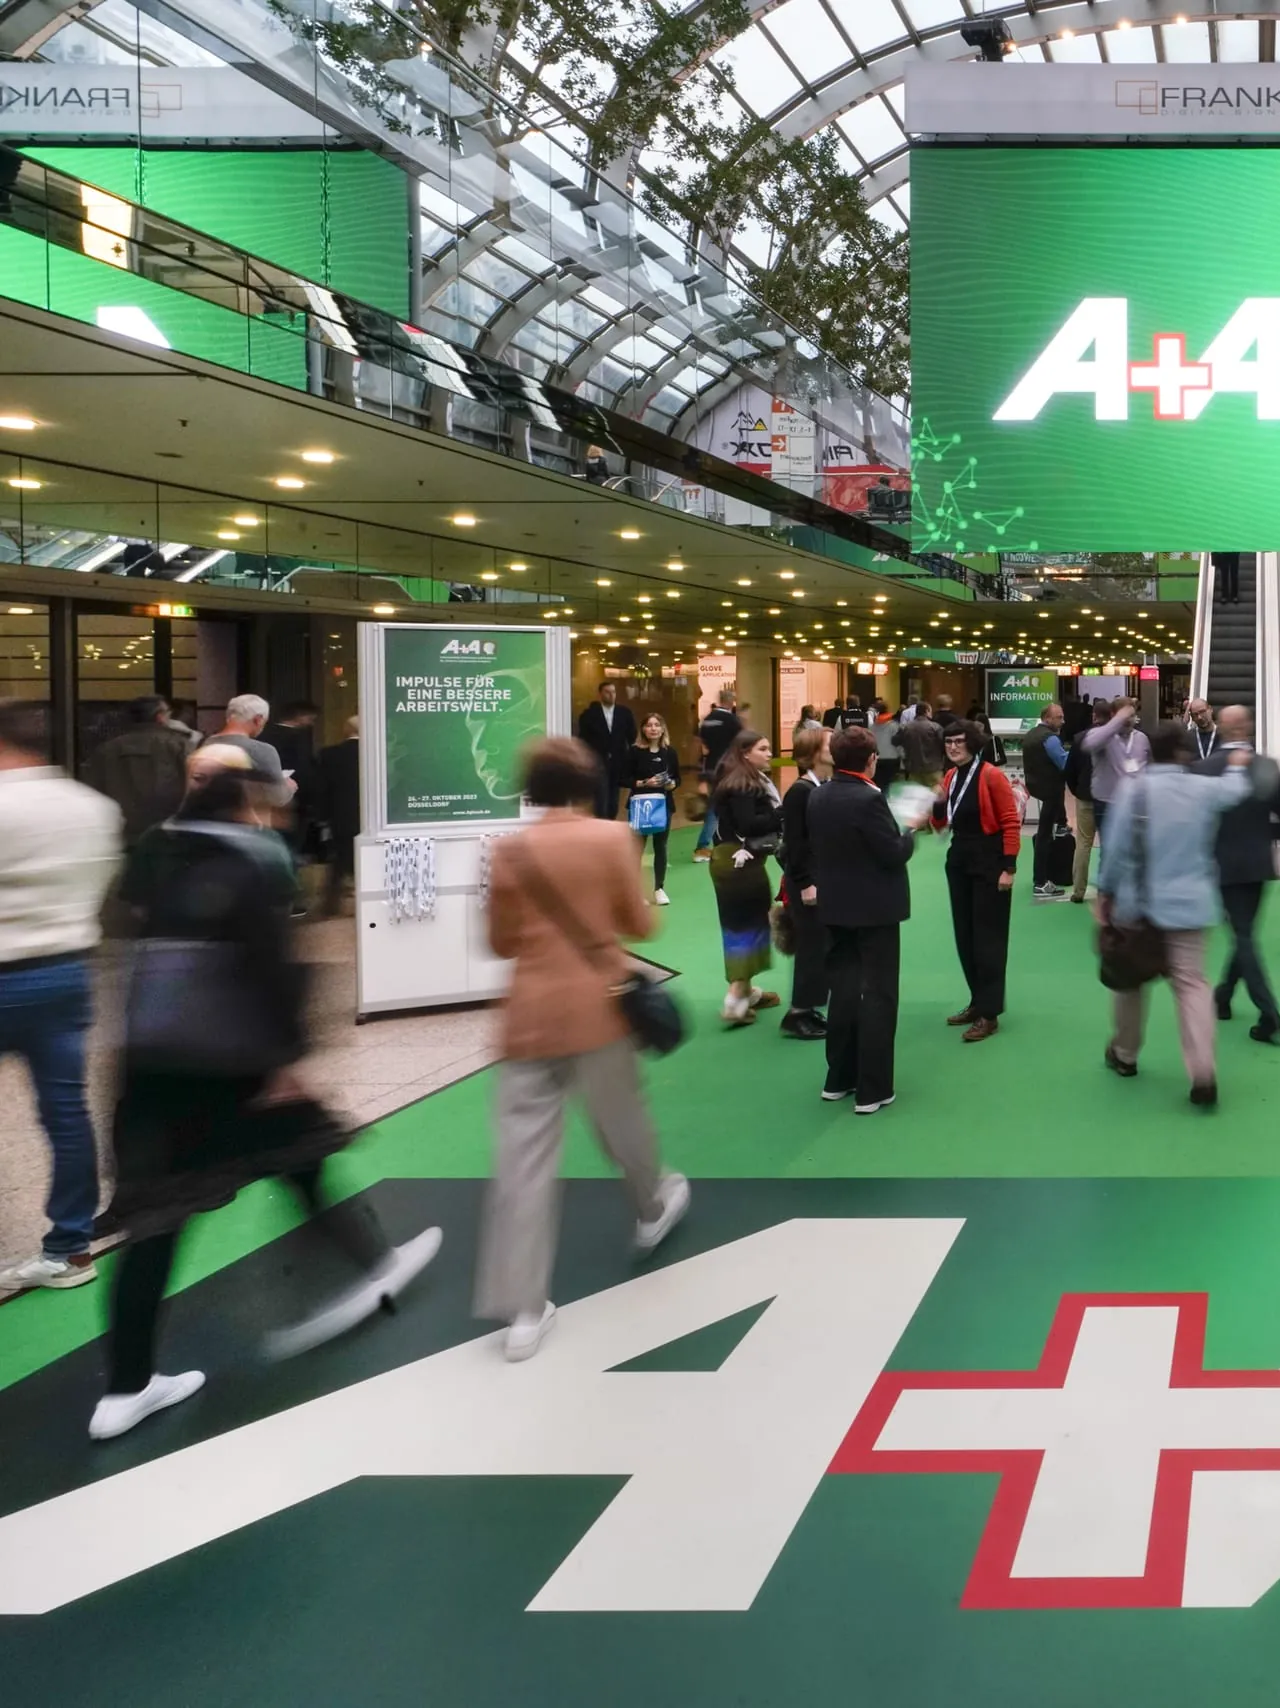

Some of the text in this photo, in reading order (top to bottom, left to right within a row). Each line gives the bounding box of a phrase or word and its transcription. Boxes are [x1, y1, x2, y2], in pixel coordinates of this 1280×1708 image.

[440, 639, 480, 655] A+A
[396, 674, 494, 688] IMPULSE FÜR
[1002, 675, 1031, 688] A+A
[407, 689, 512, 701] EINE BESSERE
[990, 692, 1053, 702] INFORMATION
[395, 701, 503, 712] ARBEITSWELT.
